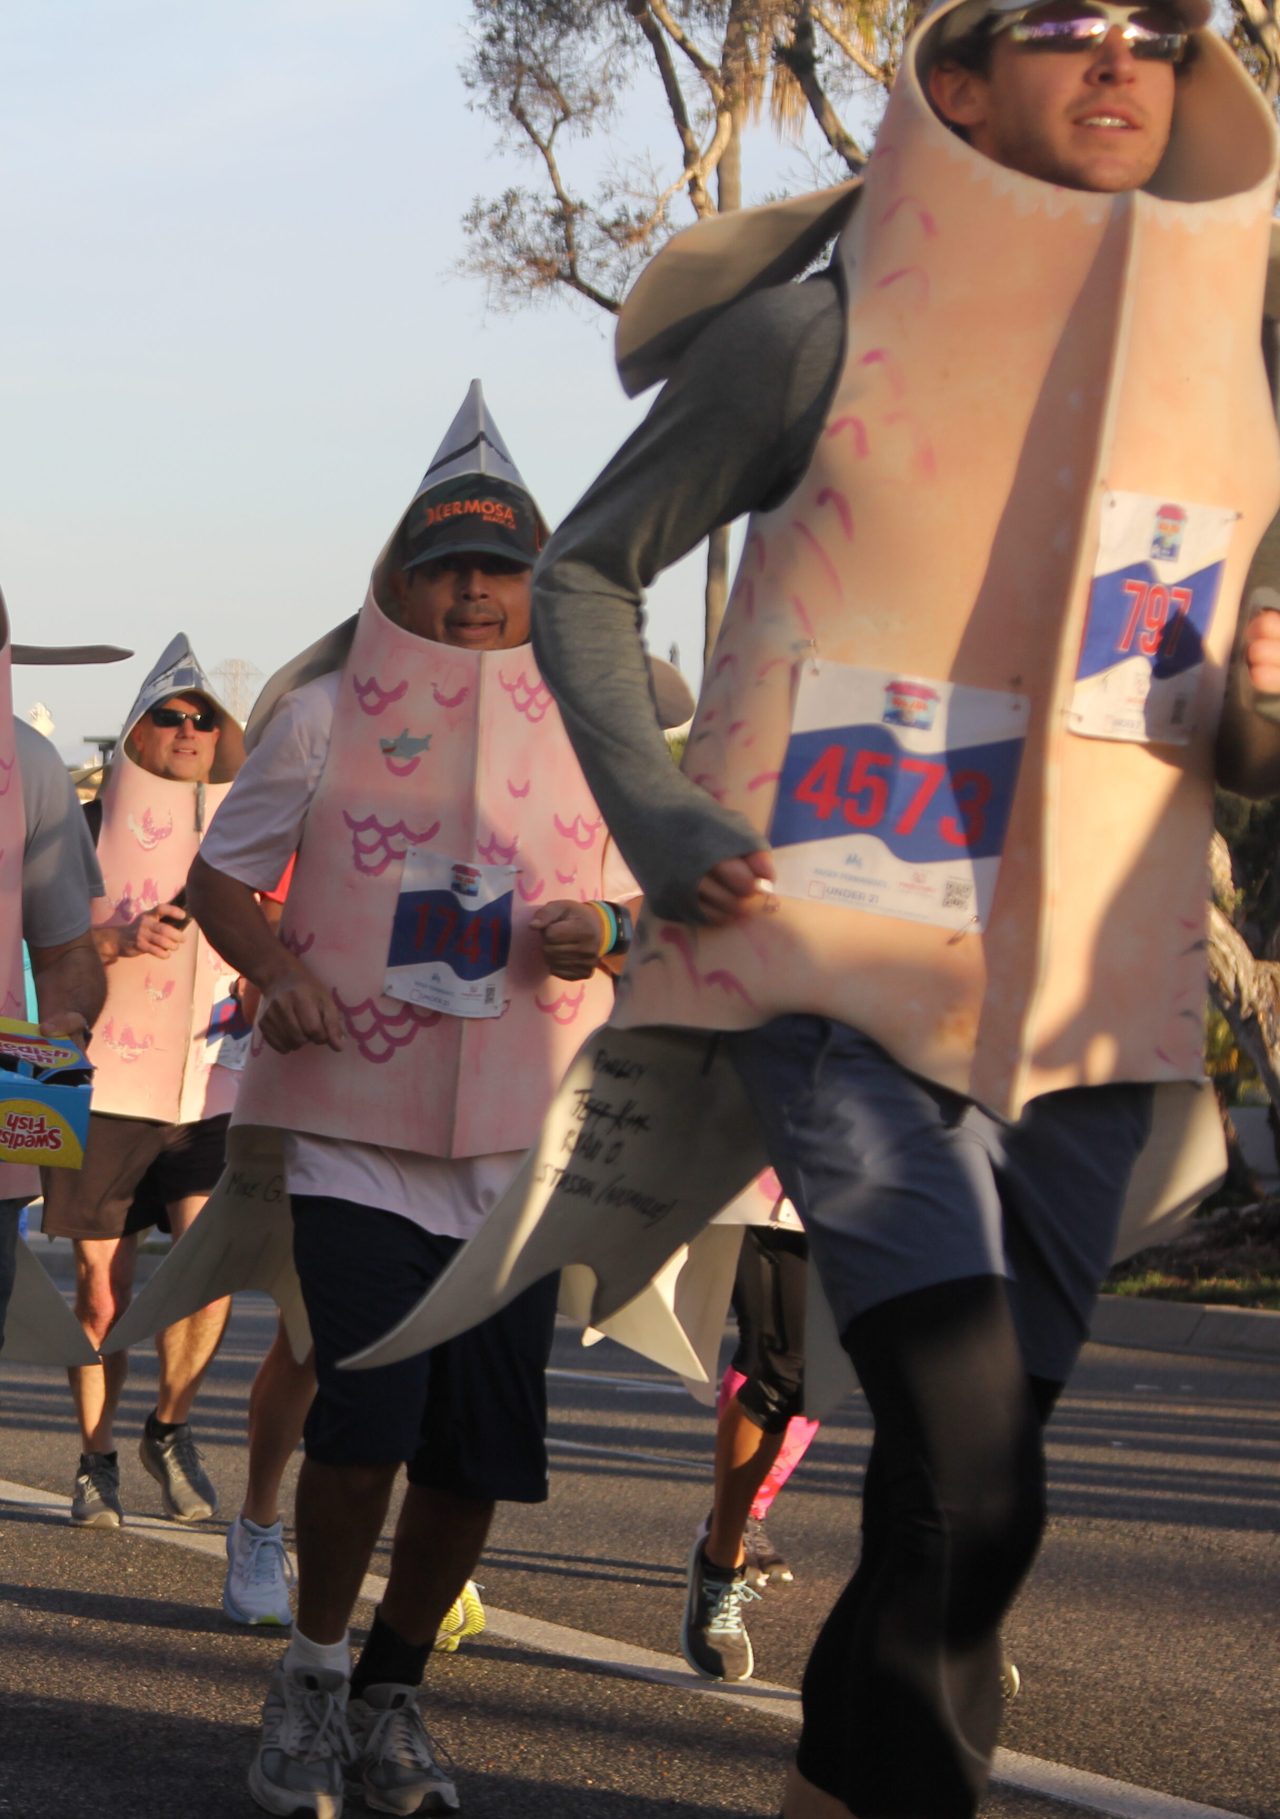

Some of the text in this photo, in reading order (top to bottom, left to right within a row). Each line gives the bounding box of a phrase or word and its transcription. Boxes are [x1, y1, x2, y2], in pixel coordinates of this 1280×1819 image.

[425, 499, 513, 527] HERMOSA
[1118, 579, 1193, 656] 797
[793, 744, 994, 848] 4573
[415, 902, 501, 966] 1741
[6, 1112, 47, 1134] Fish
